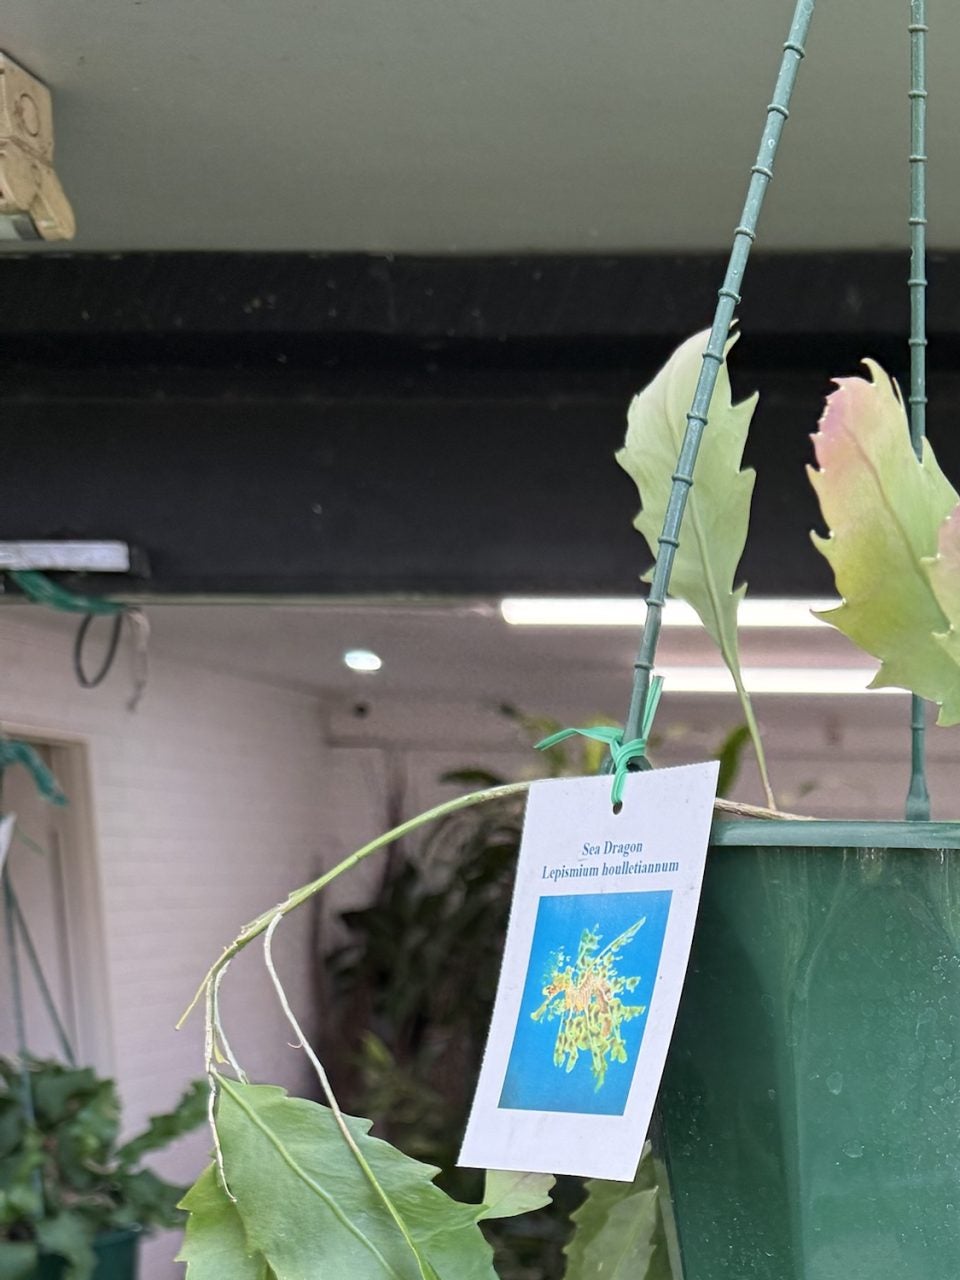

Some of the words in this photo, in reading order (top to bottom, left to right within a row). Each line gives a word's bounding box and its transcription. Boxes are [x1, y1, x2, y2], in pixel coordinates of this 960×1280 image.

[582, 842, 600, 856] Sea
[604, 840, 643, 857] Dragon
[542, 864, 599, 882] Lepismium
[601, 860, 680, 876] houlletiannum
